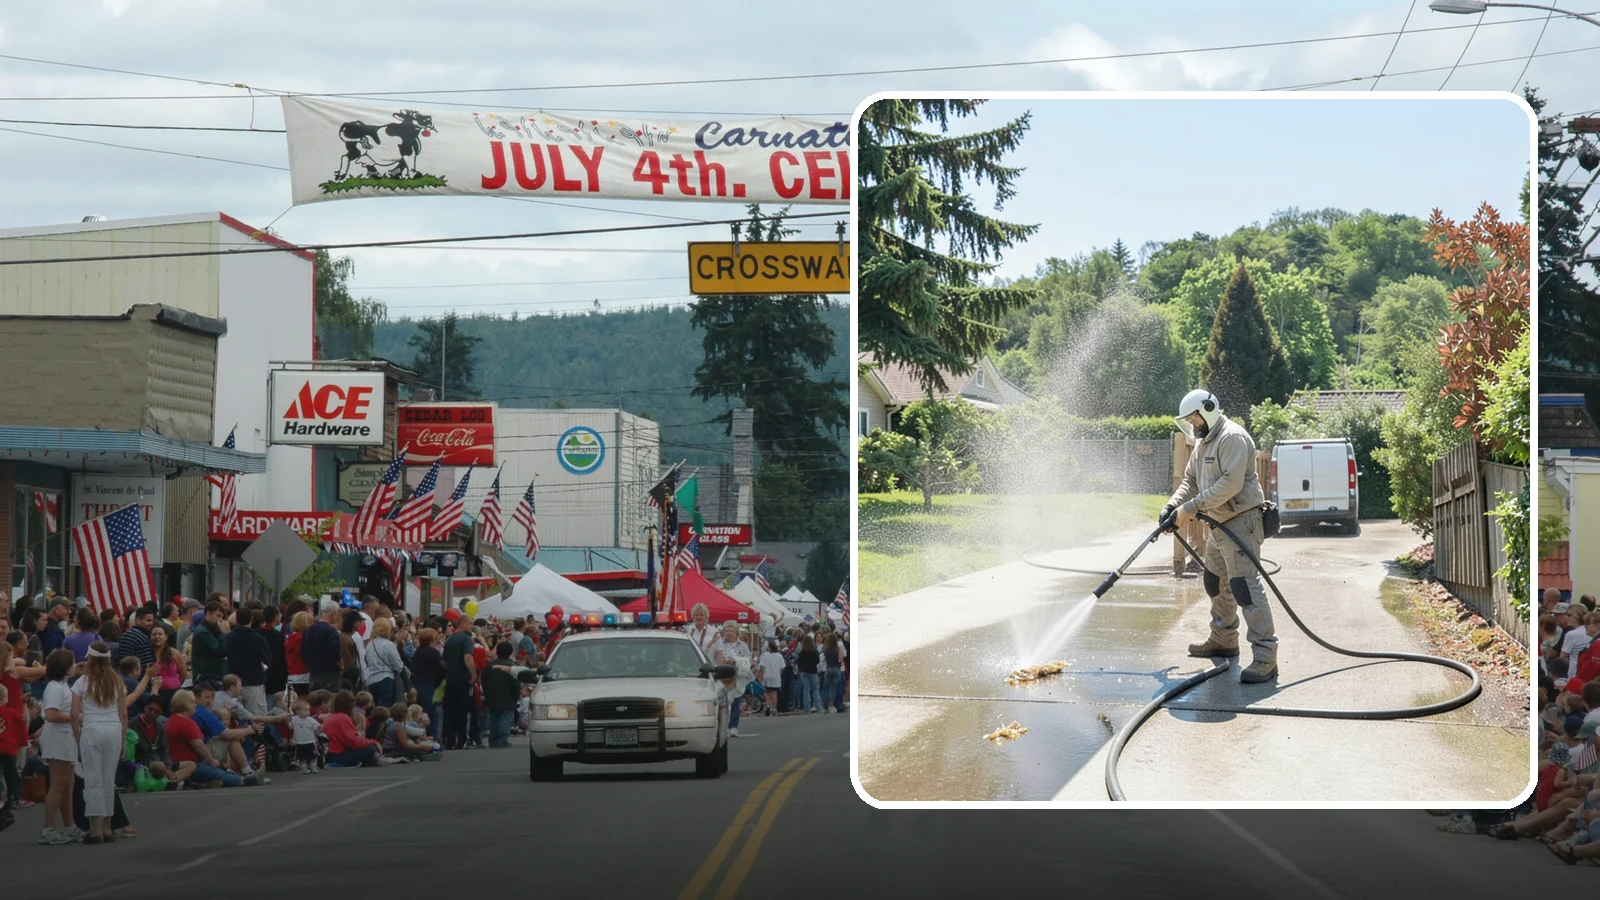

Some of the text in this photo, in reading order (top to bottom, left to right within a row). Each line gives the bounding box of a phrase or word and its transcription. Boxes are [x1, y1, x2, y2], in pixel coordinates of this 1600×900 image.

[481, 141, 605, 192] JULY
[632, 150, 747, 198] 4th.
[697, 254, 850, 280] CROSSWA
[282, 380, 373, 420] ACE
[405, 409, 485, 422] CEDAR LOG
[283, 421, 371, 437] Hardware
[416, 428, 477, 447] Coca-Cola
[96, 485, 124, 495] Vincent
[126, 486, 136, 495] de
[138, 486, 155, 495] Paul
[699, 535, 730, 543] GLASS
